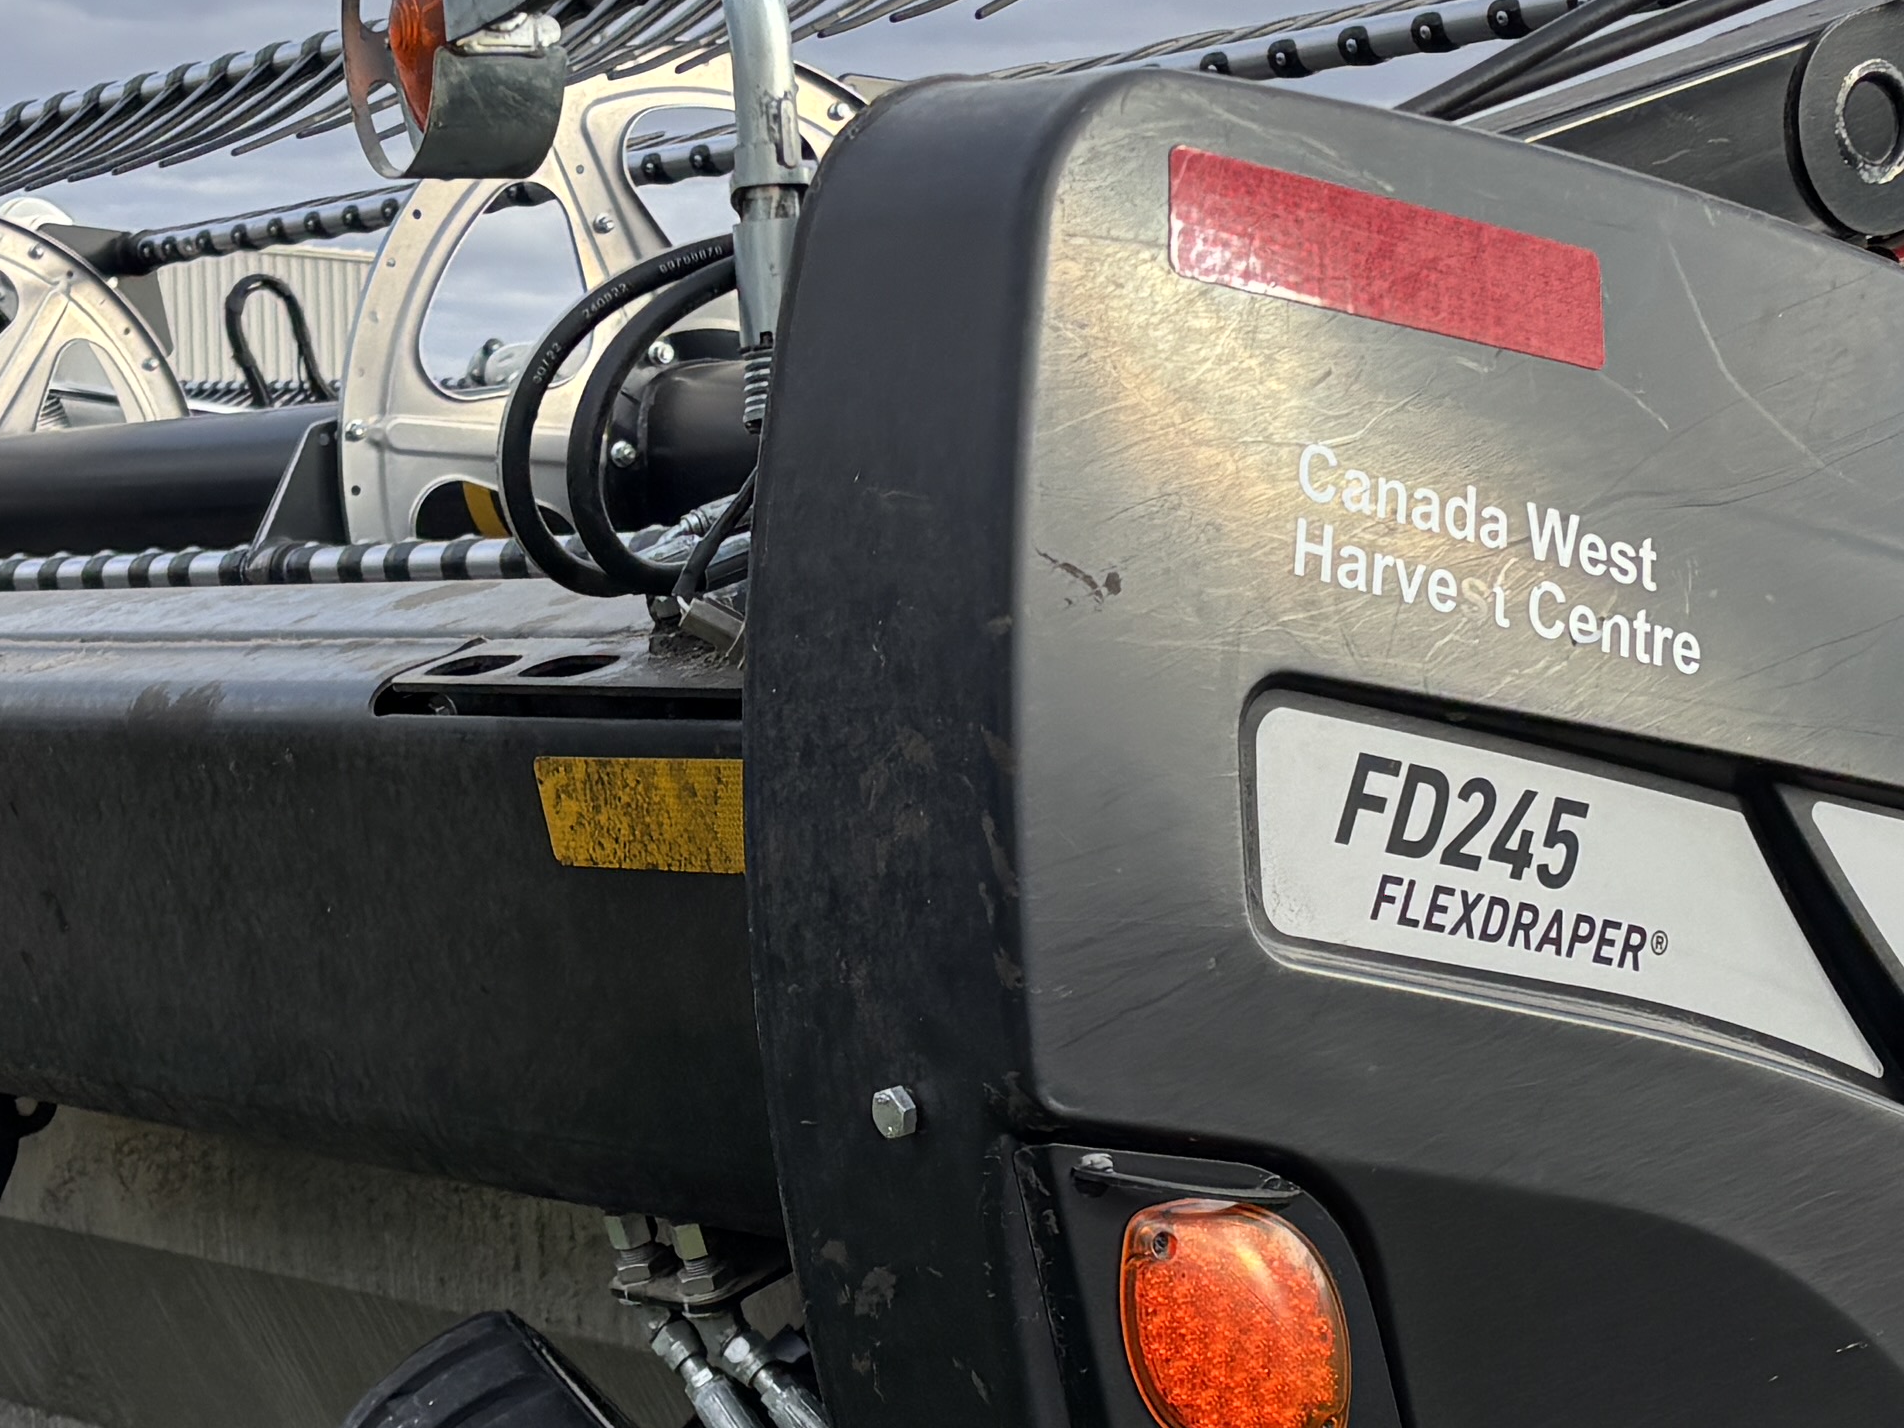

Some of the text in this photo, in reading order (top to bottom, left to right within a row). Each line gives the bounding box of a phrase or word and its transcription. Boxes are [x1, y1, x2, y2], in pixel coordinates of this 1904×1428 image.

[1297, 443, 1658, 592] Canada West
[1528, 580, 1702, 675] Centre
[1334, 751, 1589, 890] FD245
